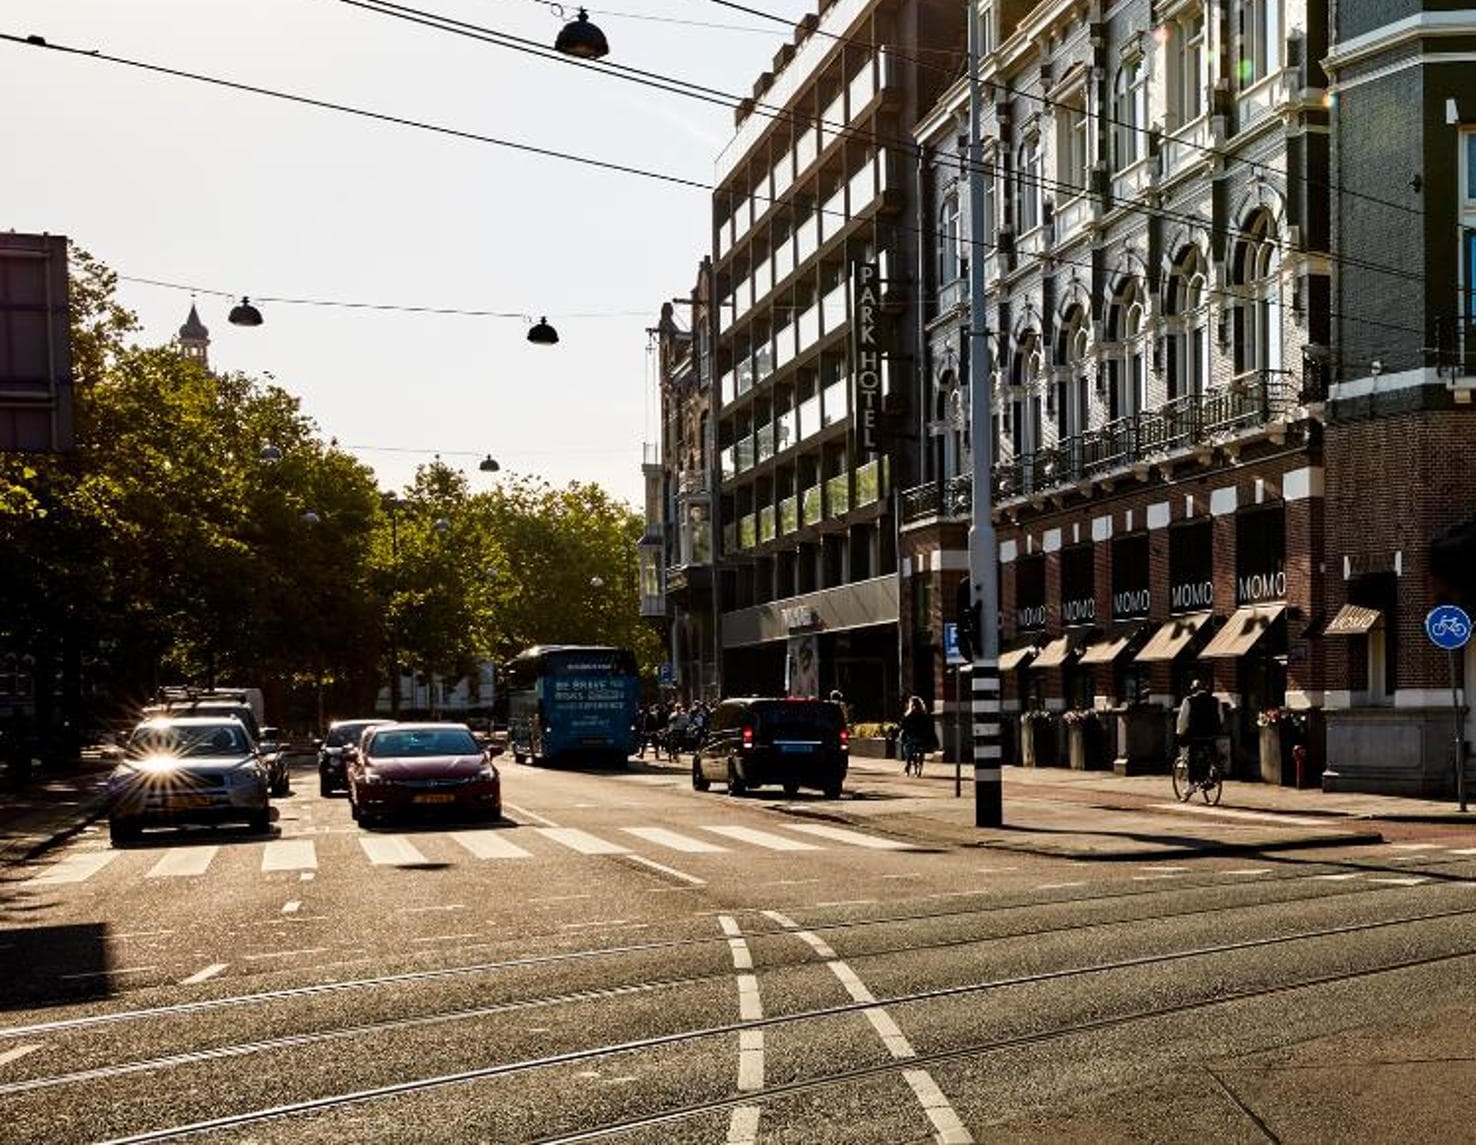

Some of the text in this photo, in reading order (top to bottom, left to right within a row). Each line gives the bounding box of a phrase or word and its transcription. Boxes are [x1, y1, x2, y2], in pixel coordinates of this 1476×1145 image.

[859, 266, 879, 447] PARK HOTEL
[1172, 582, 1213, 607] MOMO
[1240, 572, 1286, 600] MOMO
[1063, 597, 1095, 621] MOMO
[1114, 589, 1150, 613] MOMO
